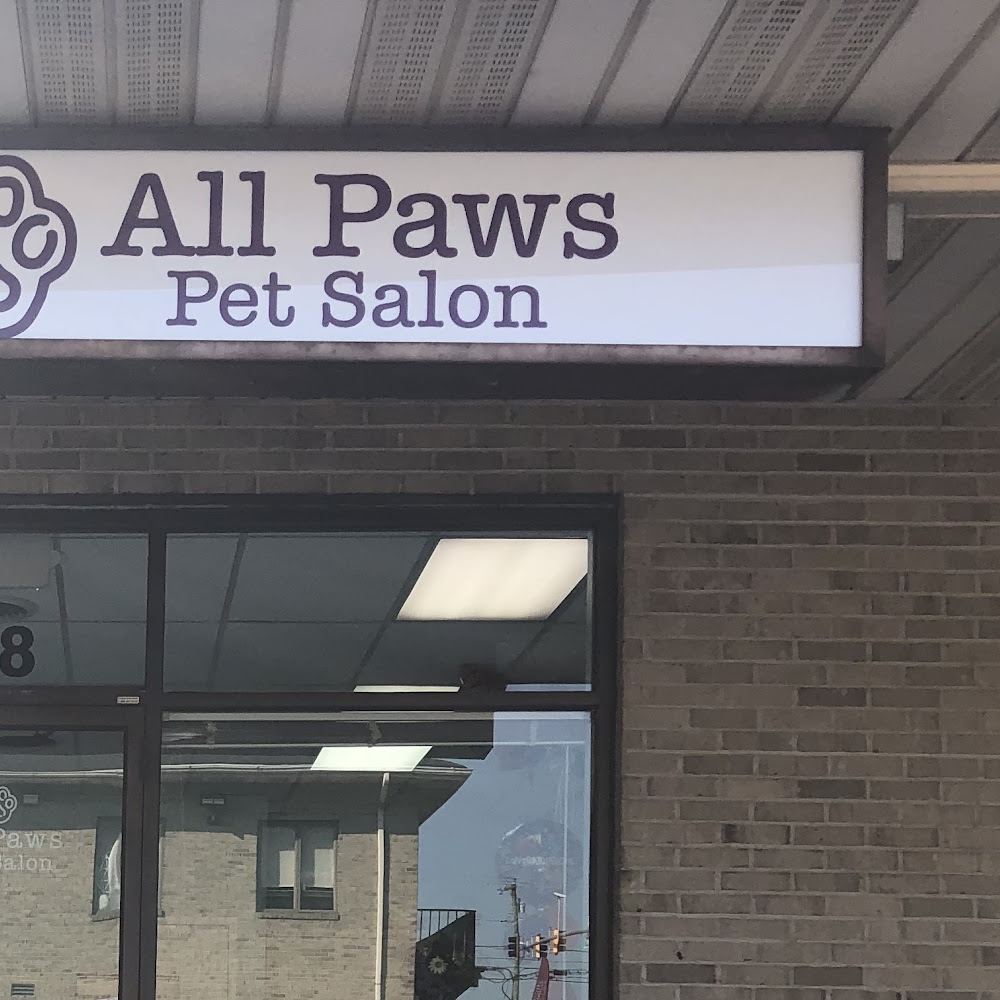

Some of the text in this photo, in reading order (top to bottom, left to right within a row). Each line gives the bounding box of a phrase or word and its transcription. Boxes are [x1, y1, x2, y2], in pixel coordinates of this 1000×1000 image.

[101, 170, 619, 260] All Paws
[165, 269, 548, 328] Pet Salon
